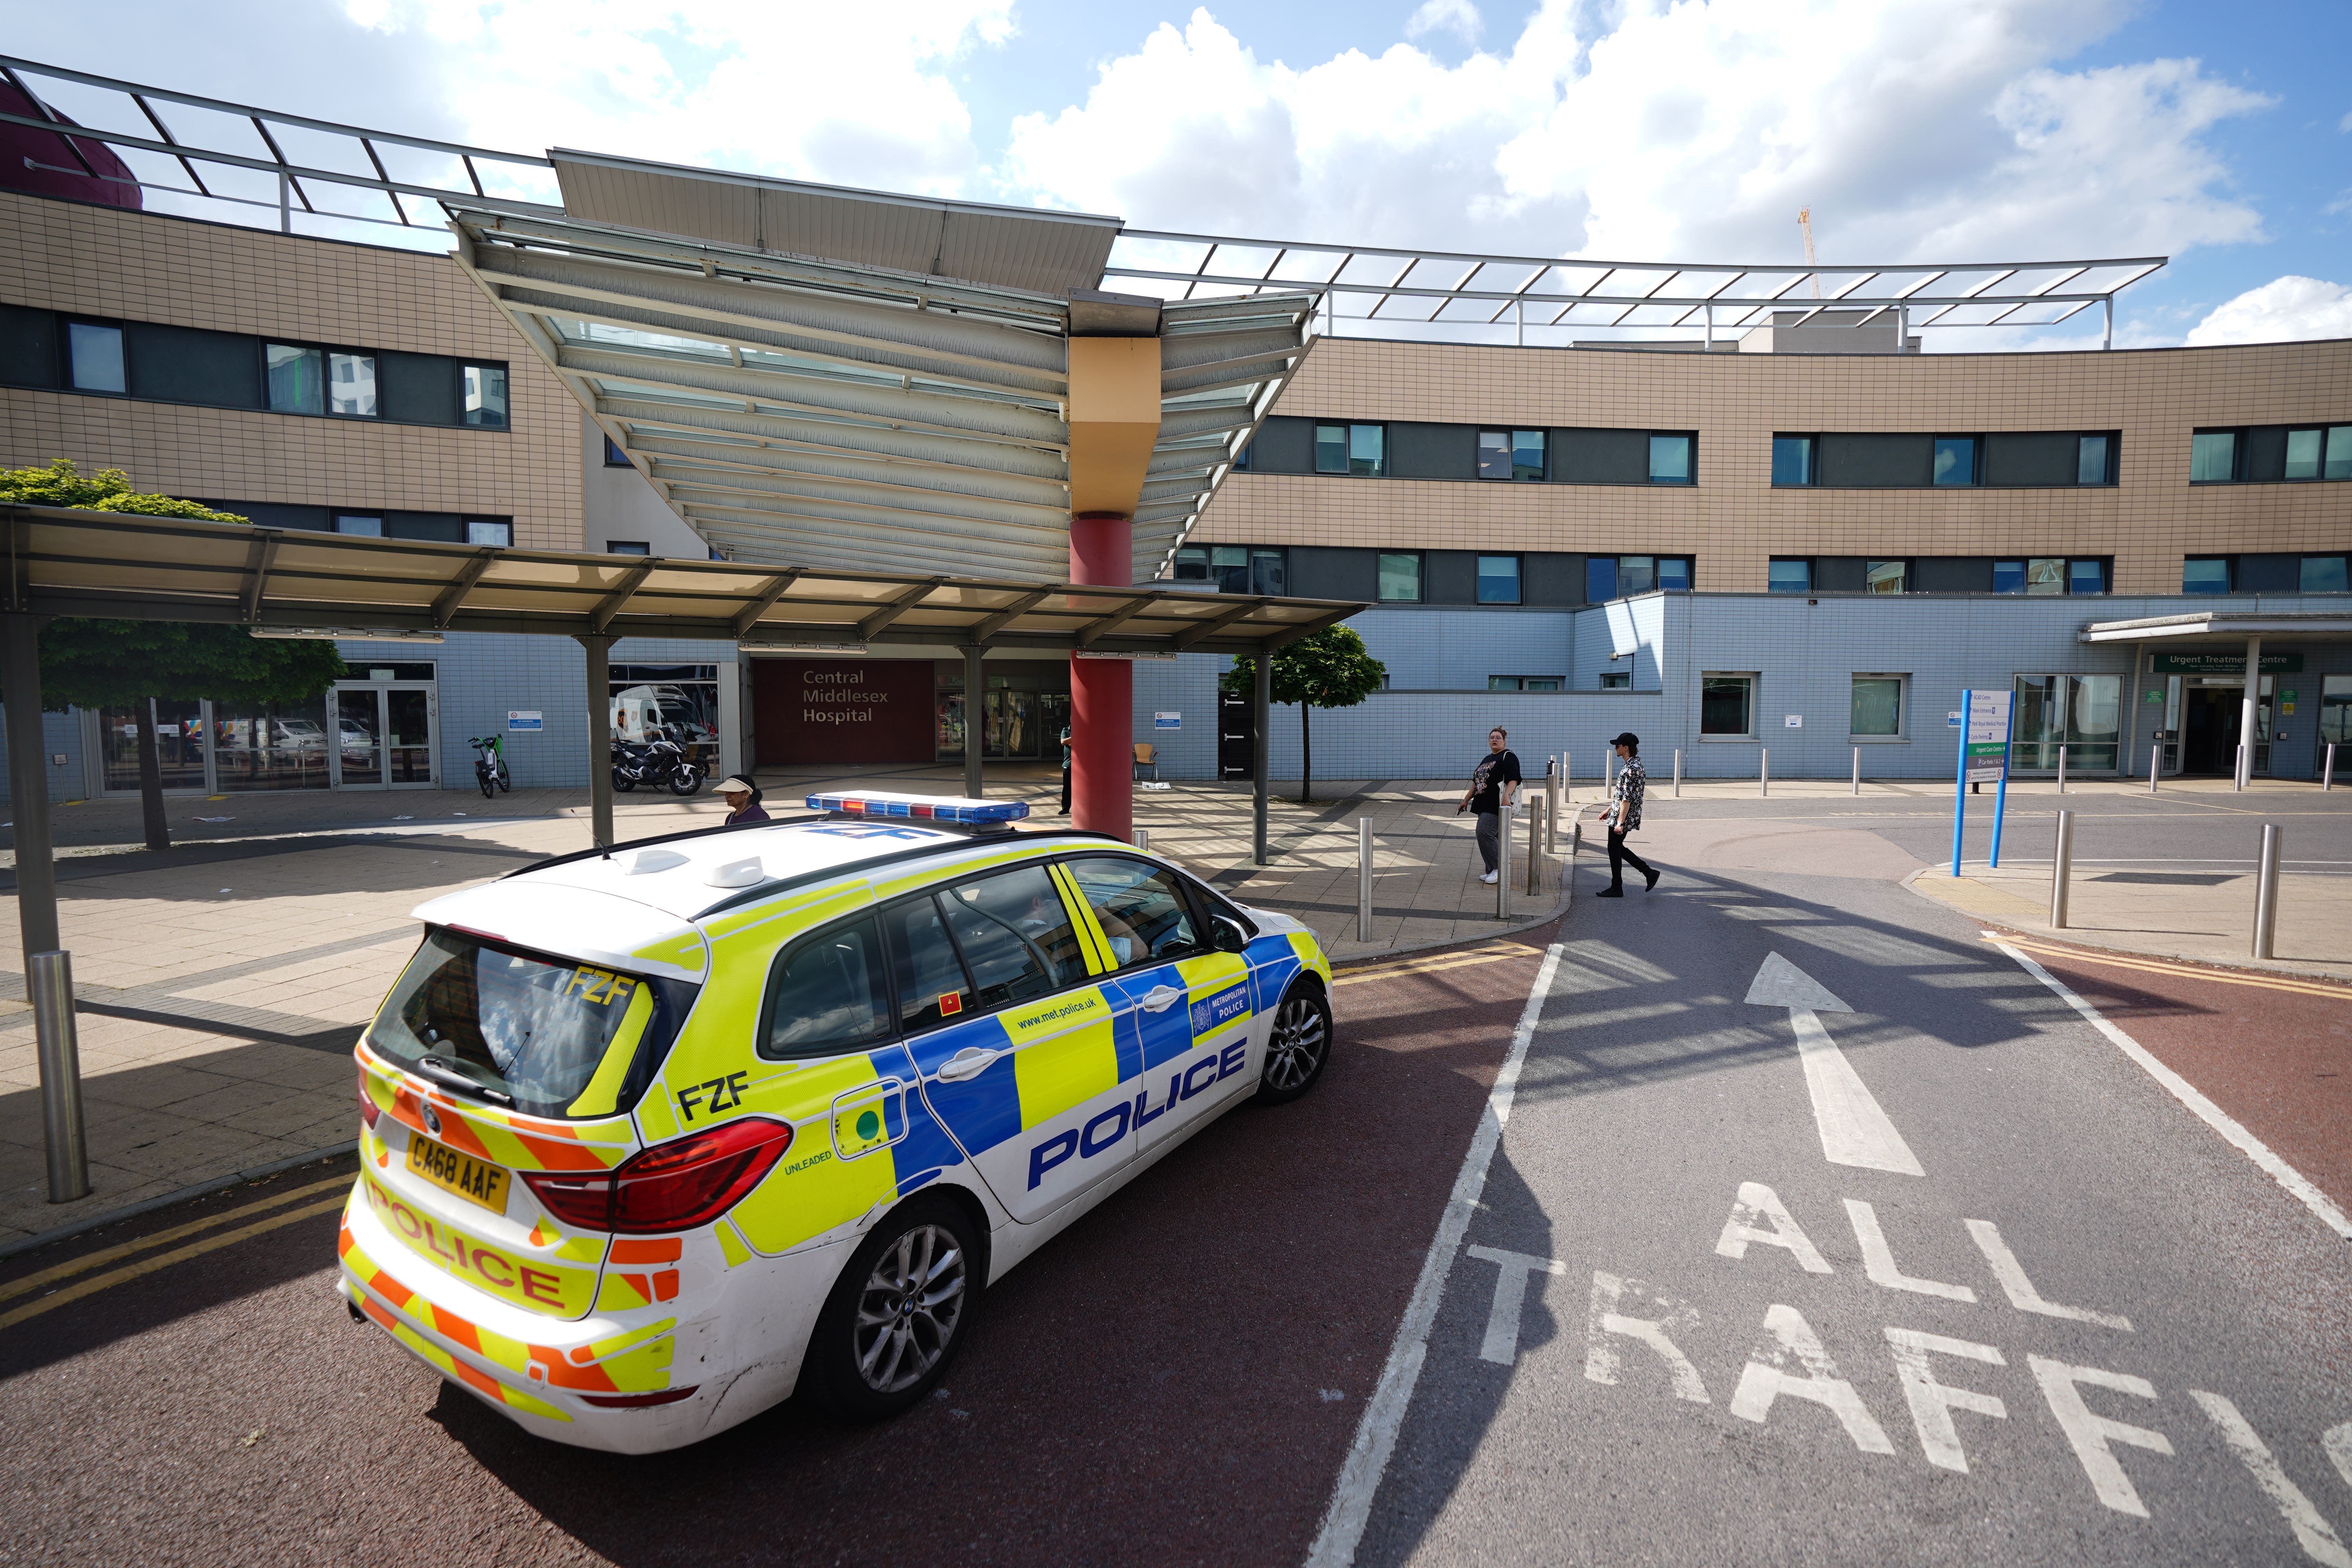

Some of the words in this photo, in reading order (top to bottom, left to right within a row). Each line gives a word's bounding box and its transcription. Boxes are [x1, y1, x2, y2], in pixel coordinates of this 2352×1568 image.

[2170, 655, 2201, 664] Urgent
[804, 670, 863, 683] Central
[804, 689, 888, 702] Middlesex
[804, 708, 872, 725] Hospital
[564, 965, 636, 1006] FZF
[1212, 986, 1246, 1008] METROPOLITAN
[1018, 998, 1096, 1029] www.met.police.uk
[1219, 1000, 1243, 1019] POLICE
[677, 1070, 748, 1121] FZF
[1027, 1036, 1247, 1192] POLICE
[413, 1136, 456, 1184] CA68
[460, 1160, 502, 1201] AAF
[785, 1151, 831, 1175] UNLEADED
[370, 1180, 565, 1309] POLICE
[1714, 1182, 2136, 1333] ALL
[1466, 1243, 2352, 1568] TRAFFI
